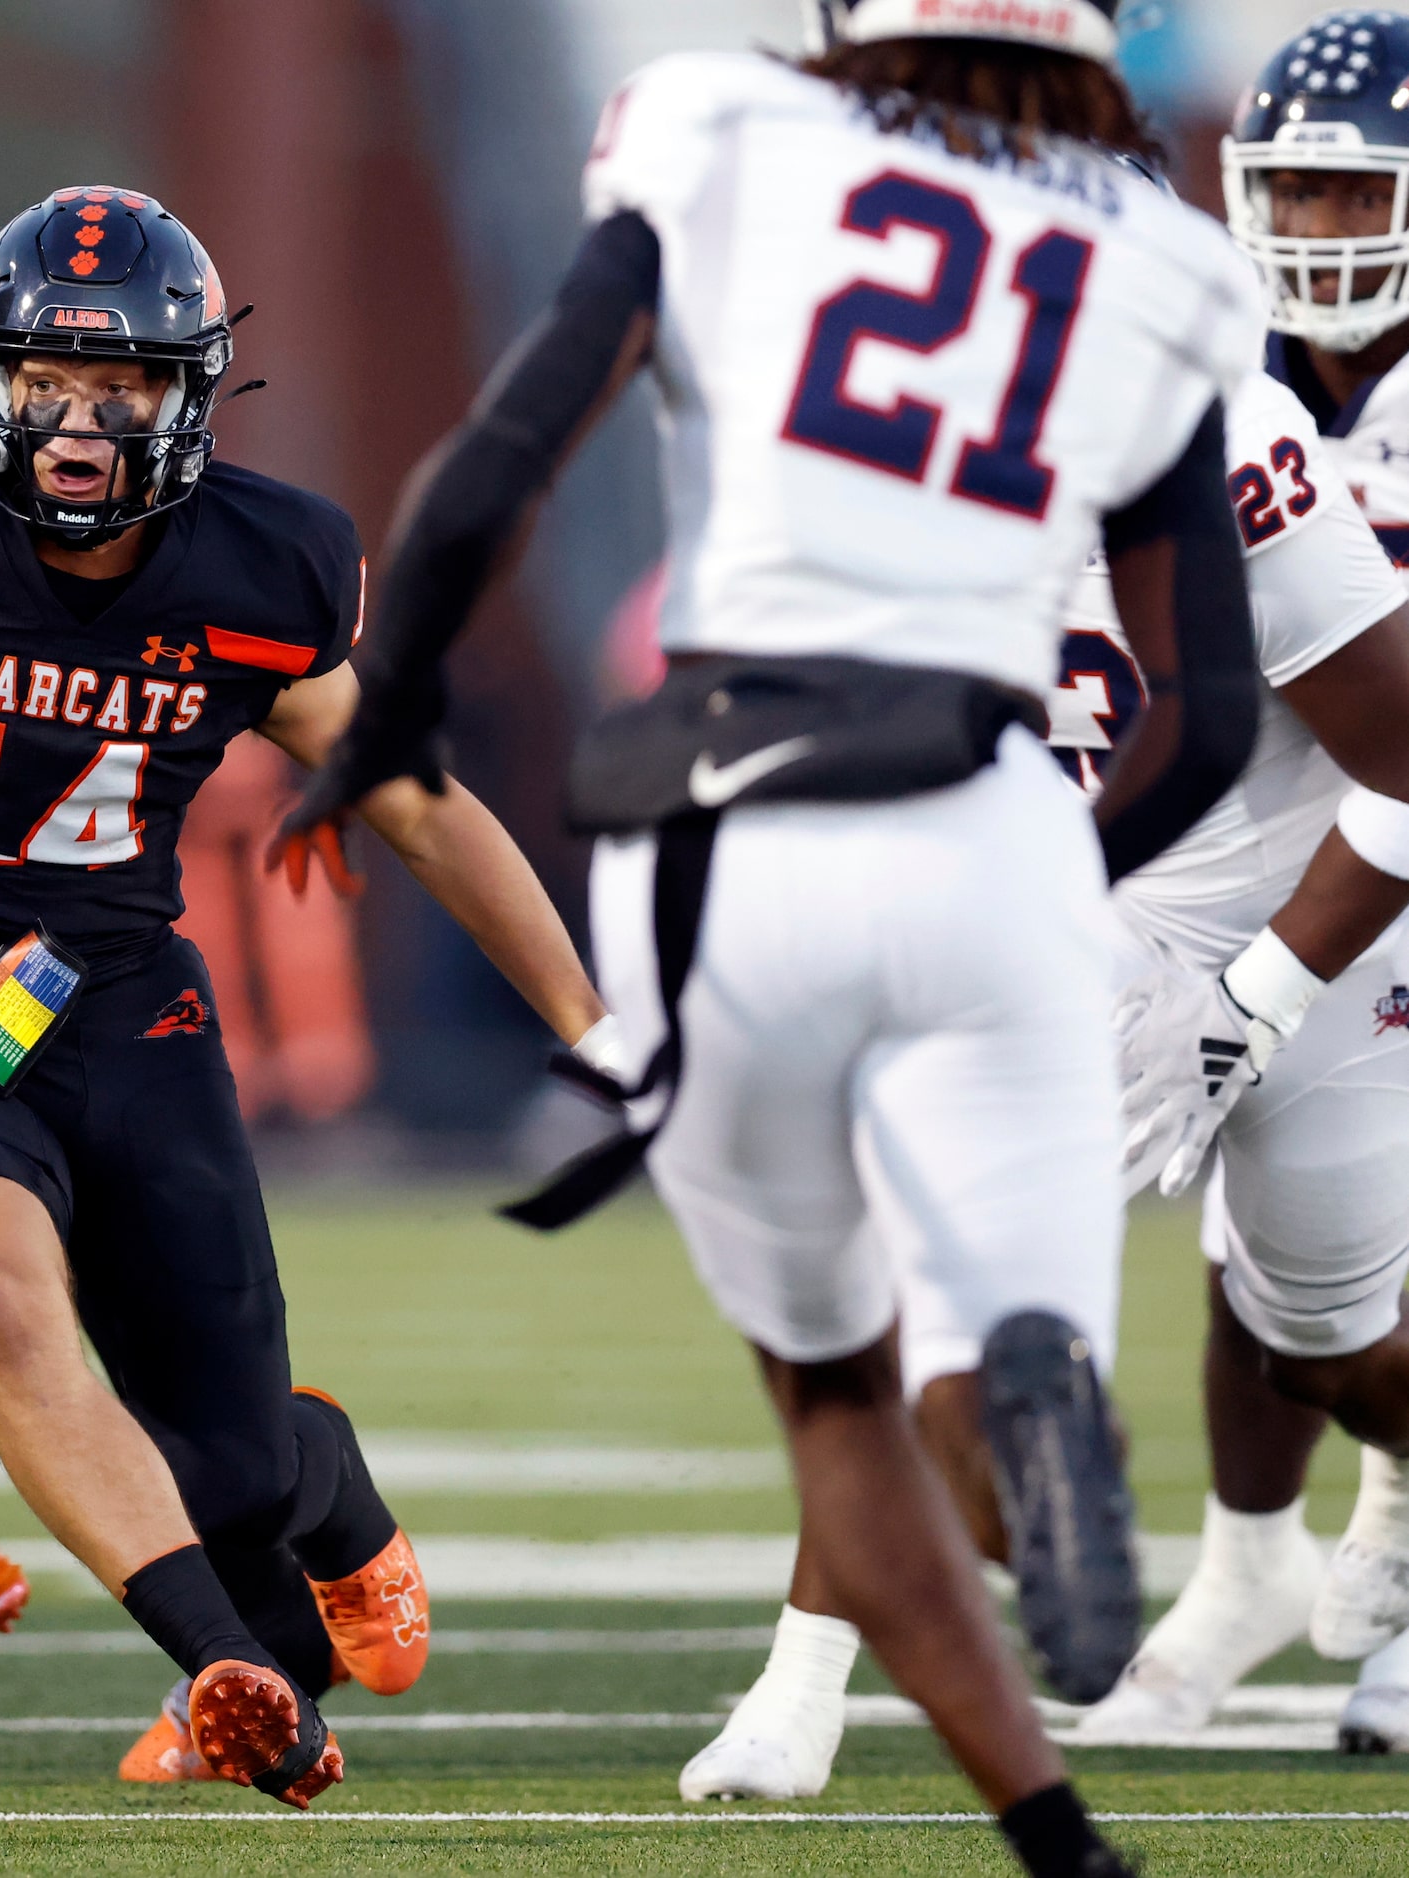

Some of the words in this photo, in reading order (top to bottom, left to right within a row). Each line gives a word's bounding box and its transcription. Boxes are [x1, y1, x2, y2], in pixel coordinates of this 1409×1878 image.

[53, 308, 110, 329] ALEDO
[778, 165, 1095, 522] 21
[56, 510, 96, 525] Riddell
[1227, 435, 1318, 549] 23
